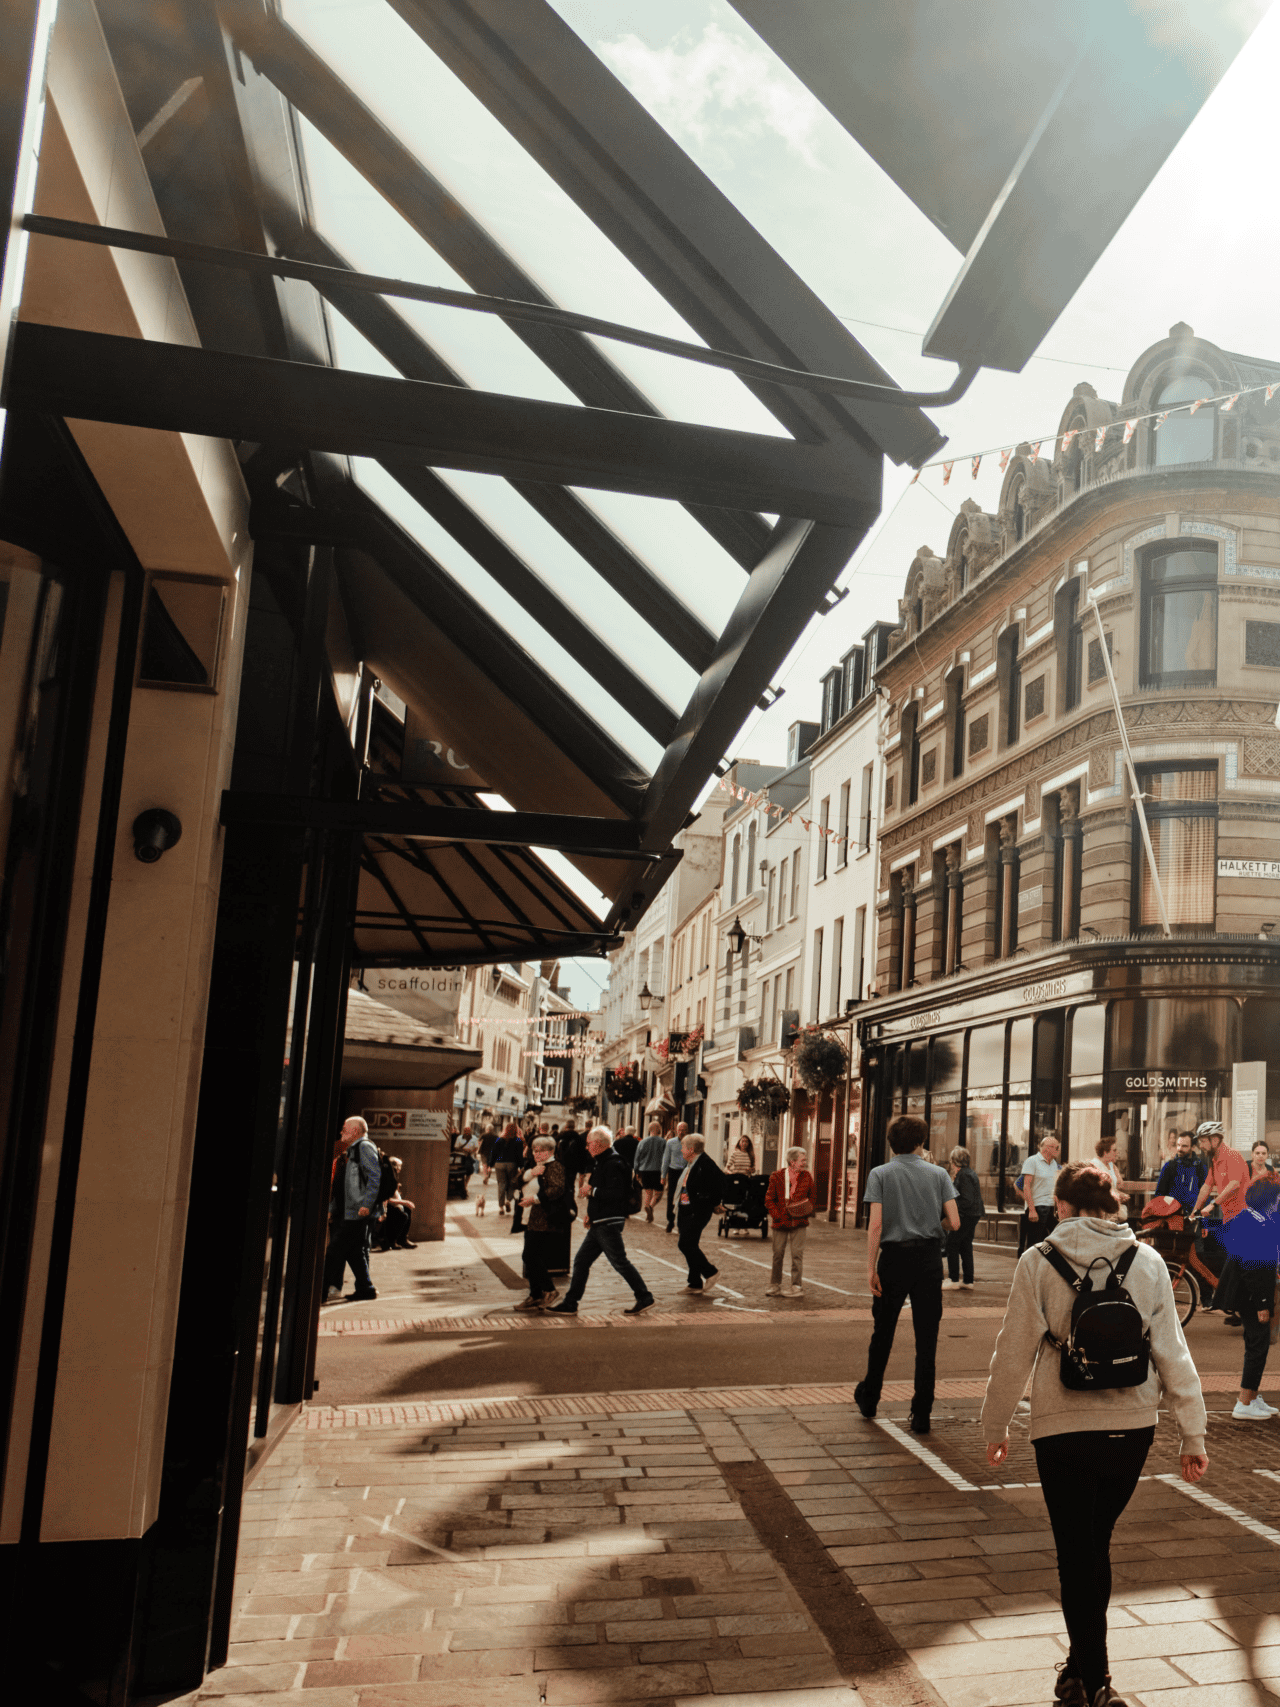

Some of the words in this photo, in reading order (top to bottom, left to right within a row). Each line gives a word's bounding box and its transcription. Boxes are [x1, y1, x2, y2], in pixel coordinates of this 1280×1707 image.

[1220, 861, 1268, 872] HALKETT
[1023, 979, 1066, 1001] GOLDSMITHS
[1125, 1077, 1207, 1088] GOLDSMITHS
[368, 1113, 402, 1127] JDC
